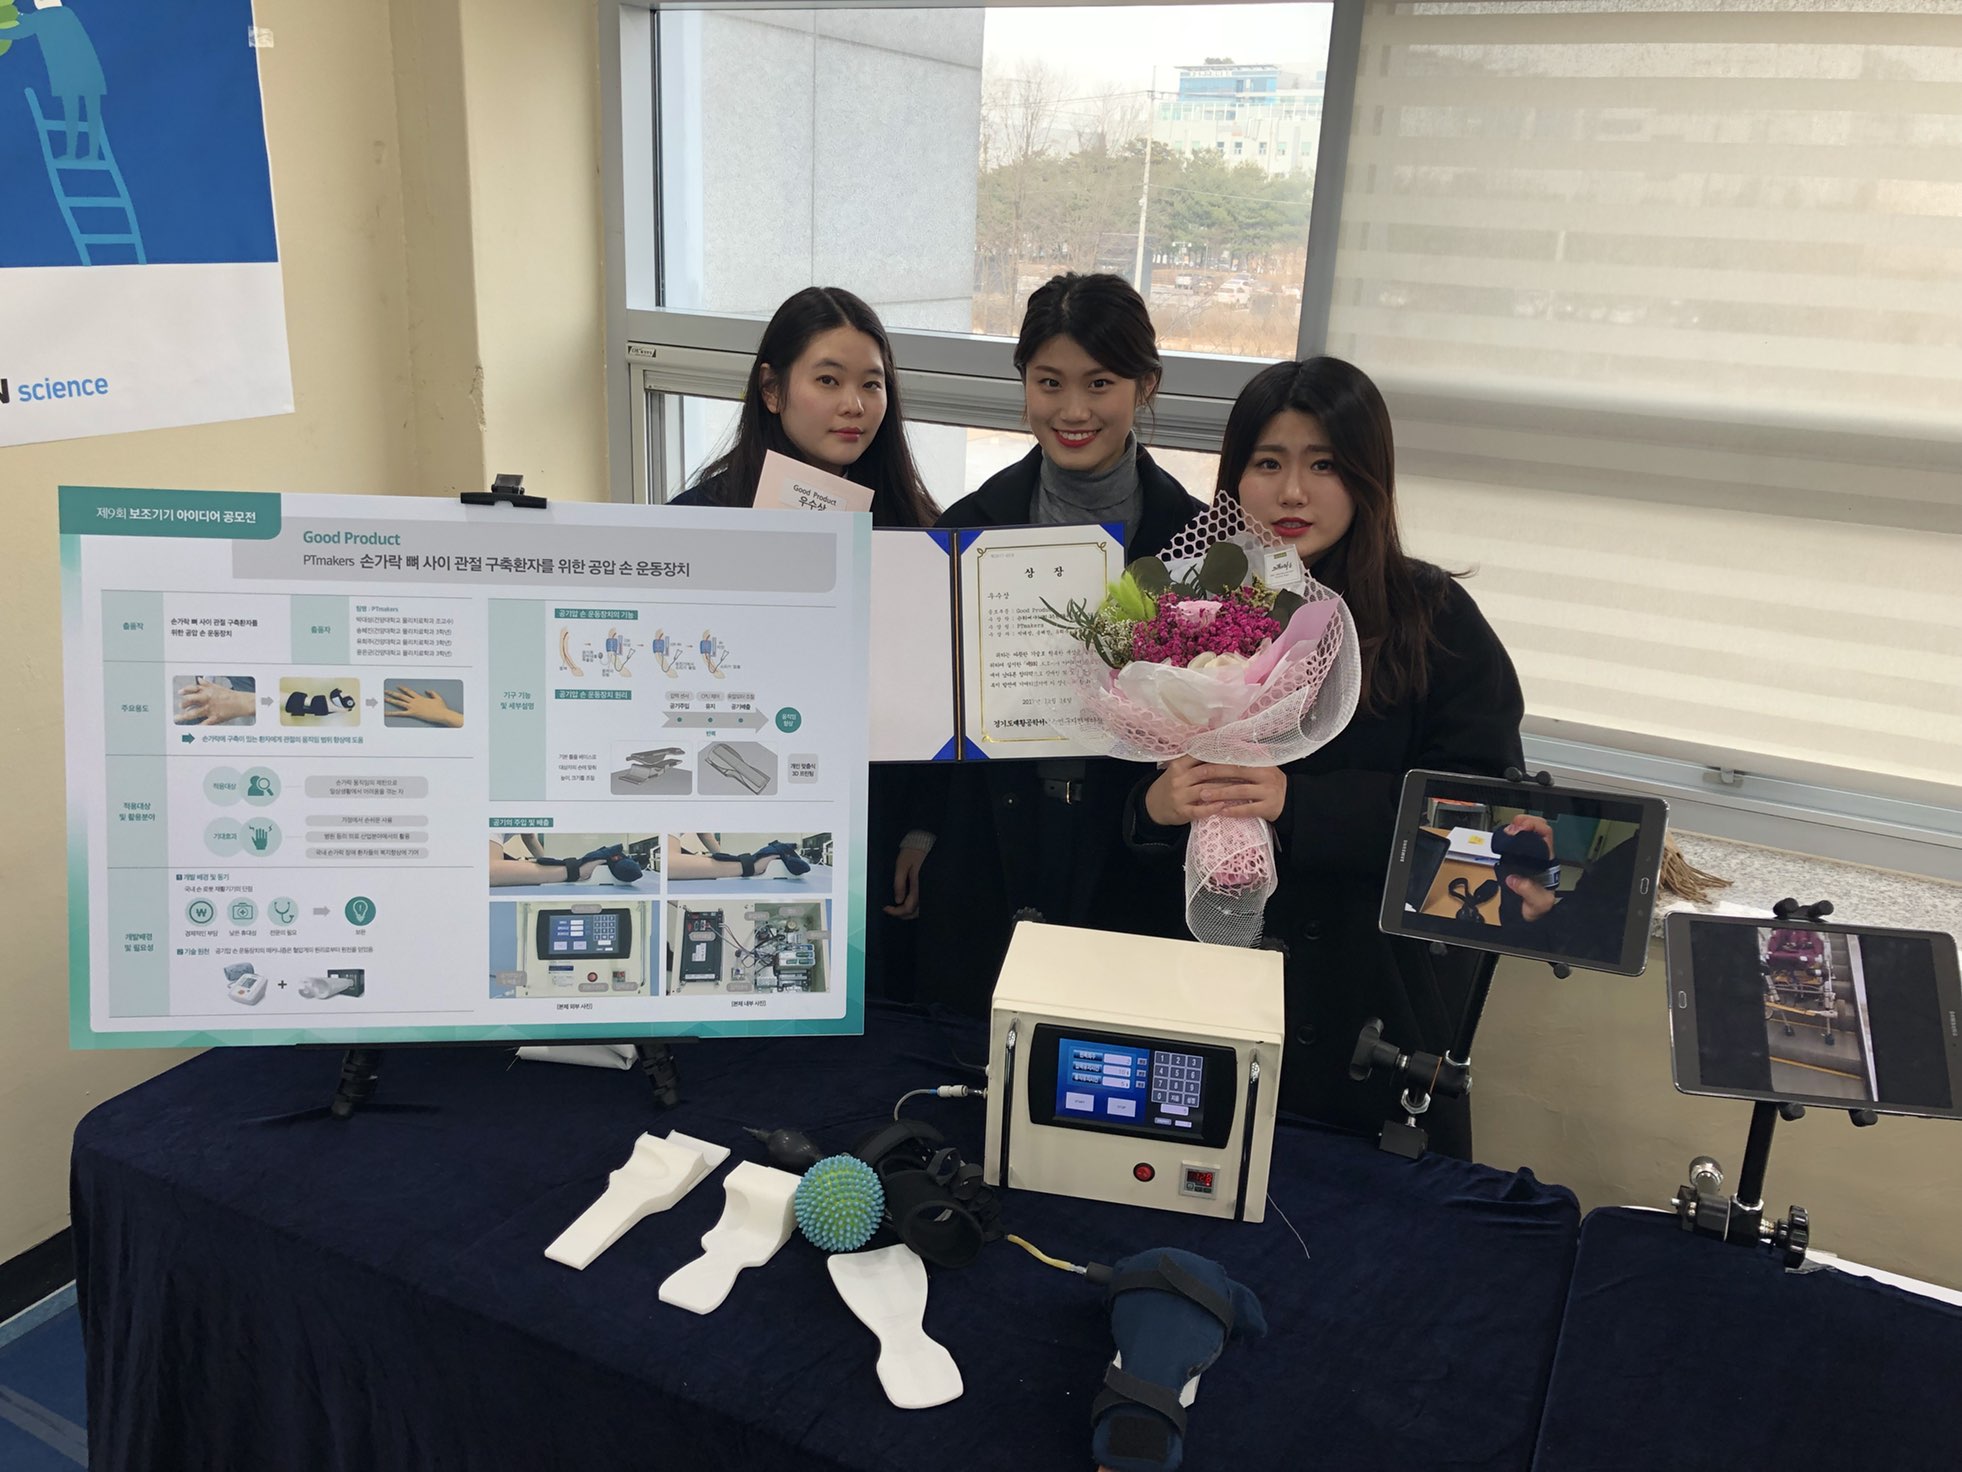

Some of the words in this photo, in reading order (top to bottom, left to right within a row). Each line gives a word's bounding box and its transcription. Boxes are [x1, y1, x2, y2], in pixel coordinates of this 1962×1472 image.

[18, 377, 109, 402] science
[793, 484, 811, 496] Good
[813, 491, 837, 506] Product
[799, 496, 827, 511] 우수상
[96, 507, 127, 520] 제9회
[129, 508, 174, 521] 보조기기
[176, 509, 221, 523] 아이디어
[223, 510, 257, 524] 공모전
[303, 530, 341, 545] Good
[344, 531, 401, 546] Product
[303, 554, 355, 567] PTmakers
[359, 554, 403, 570] 손가락
[406, 555, 419, 570] 뼈
[423, 556, 450, 571] 사이
[454, 556, 482, 572] 관절
[485, 557, 555, 574] 구축환자를
[558, 558, 585, 575] 위한
[588, 559, 616, 575] 공압
[619, 560, 633, 576] 손
[636, 561, 690, 577] 운동장치
[1025, 567, 1035, 579] 상
[1054, 565, 1064, 578] 장
[1176, 1056, 1181, 1064] 2
[1175, 1069, 1180, 1077] 5
[1190, 1071, 1195, 1079] 6
[1157, 1092, 1162, 1100] 0
